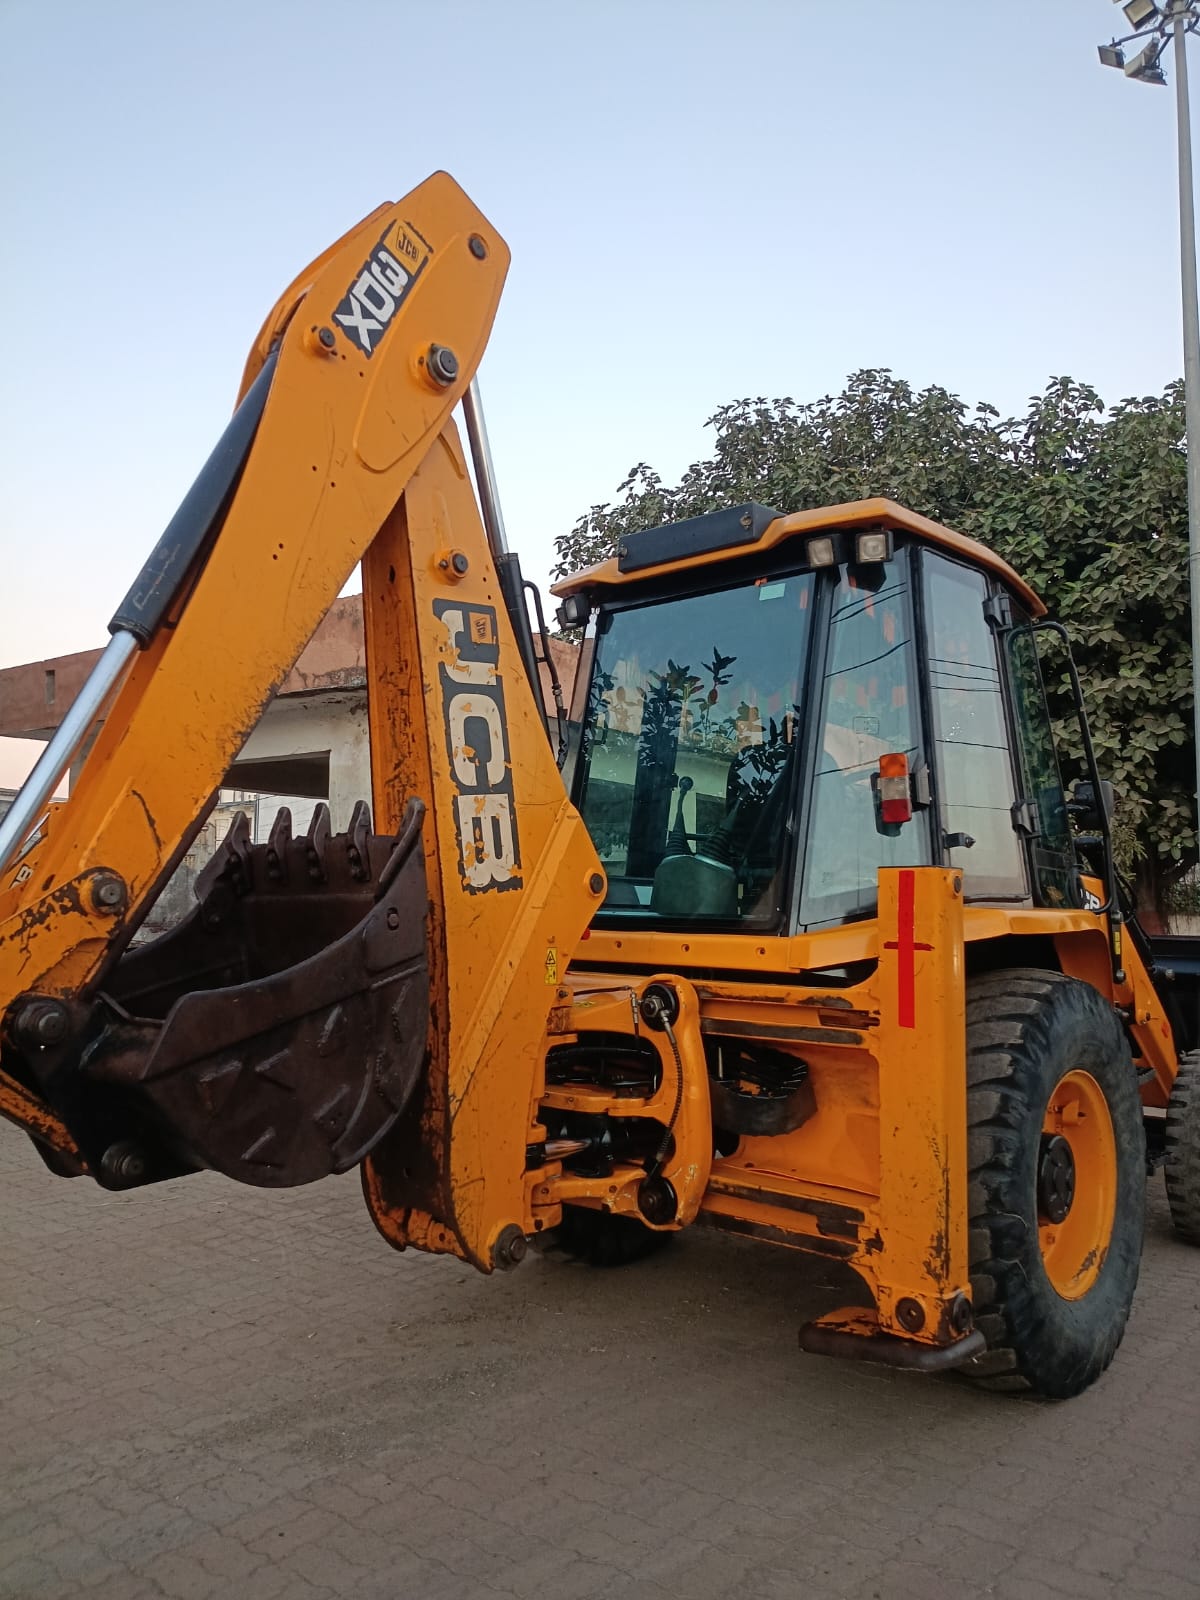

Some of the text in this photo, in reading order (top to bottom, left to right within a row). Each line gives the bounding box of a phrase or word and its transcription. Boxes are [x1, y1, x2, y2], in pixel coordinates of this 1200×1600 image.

[397, 232, 417, 260] JCB
[335, 251, 408, 352] 3DX
[441, 610, 516, 888] JCB
